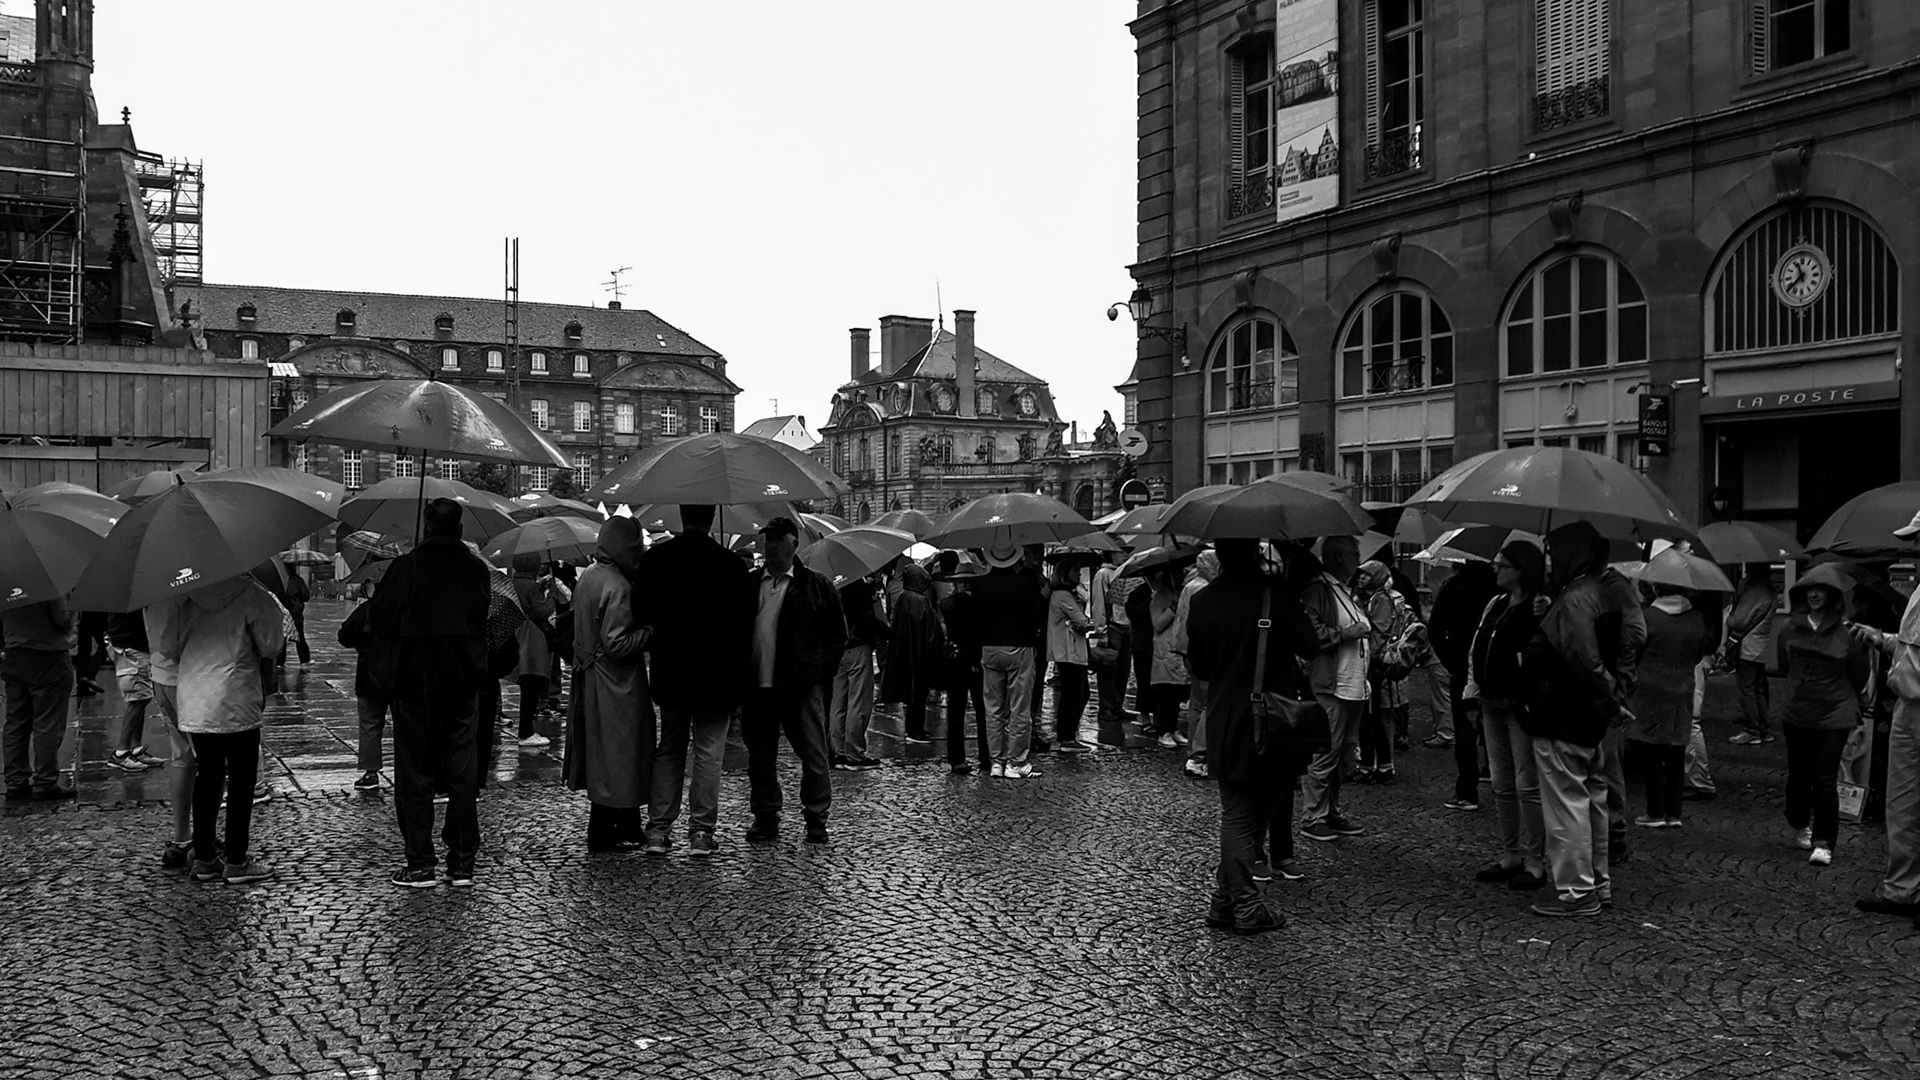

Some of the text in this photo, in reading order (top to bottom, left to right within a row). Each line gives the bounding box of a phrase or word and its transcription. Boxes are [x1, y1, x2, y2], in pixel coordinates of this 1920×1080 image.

[1737, 388, 1855, 409] LA POSTE
[1642, 419, 1667, 428] BANQUE
[1642, 427, 1667, 435] POSTALE
[169, 572, 201, 588] VIKING
